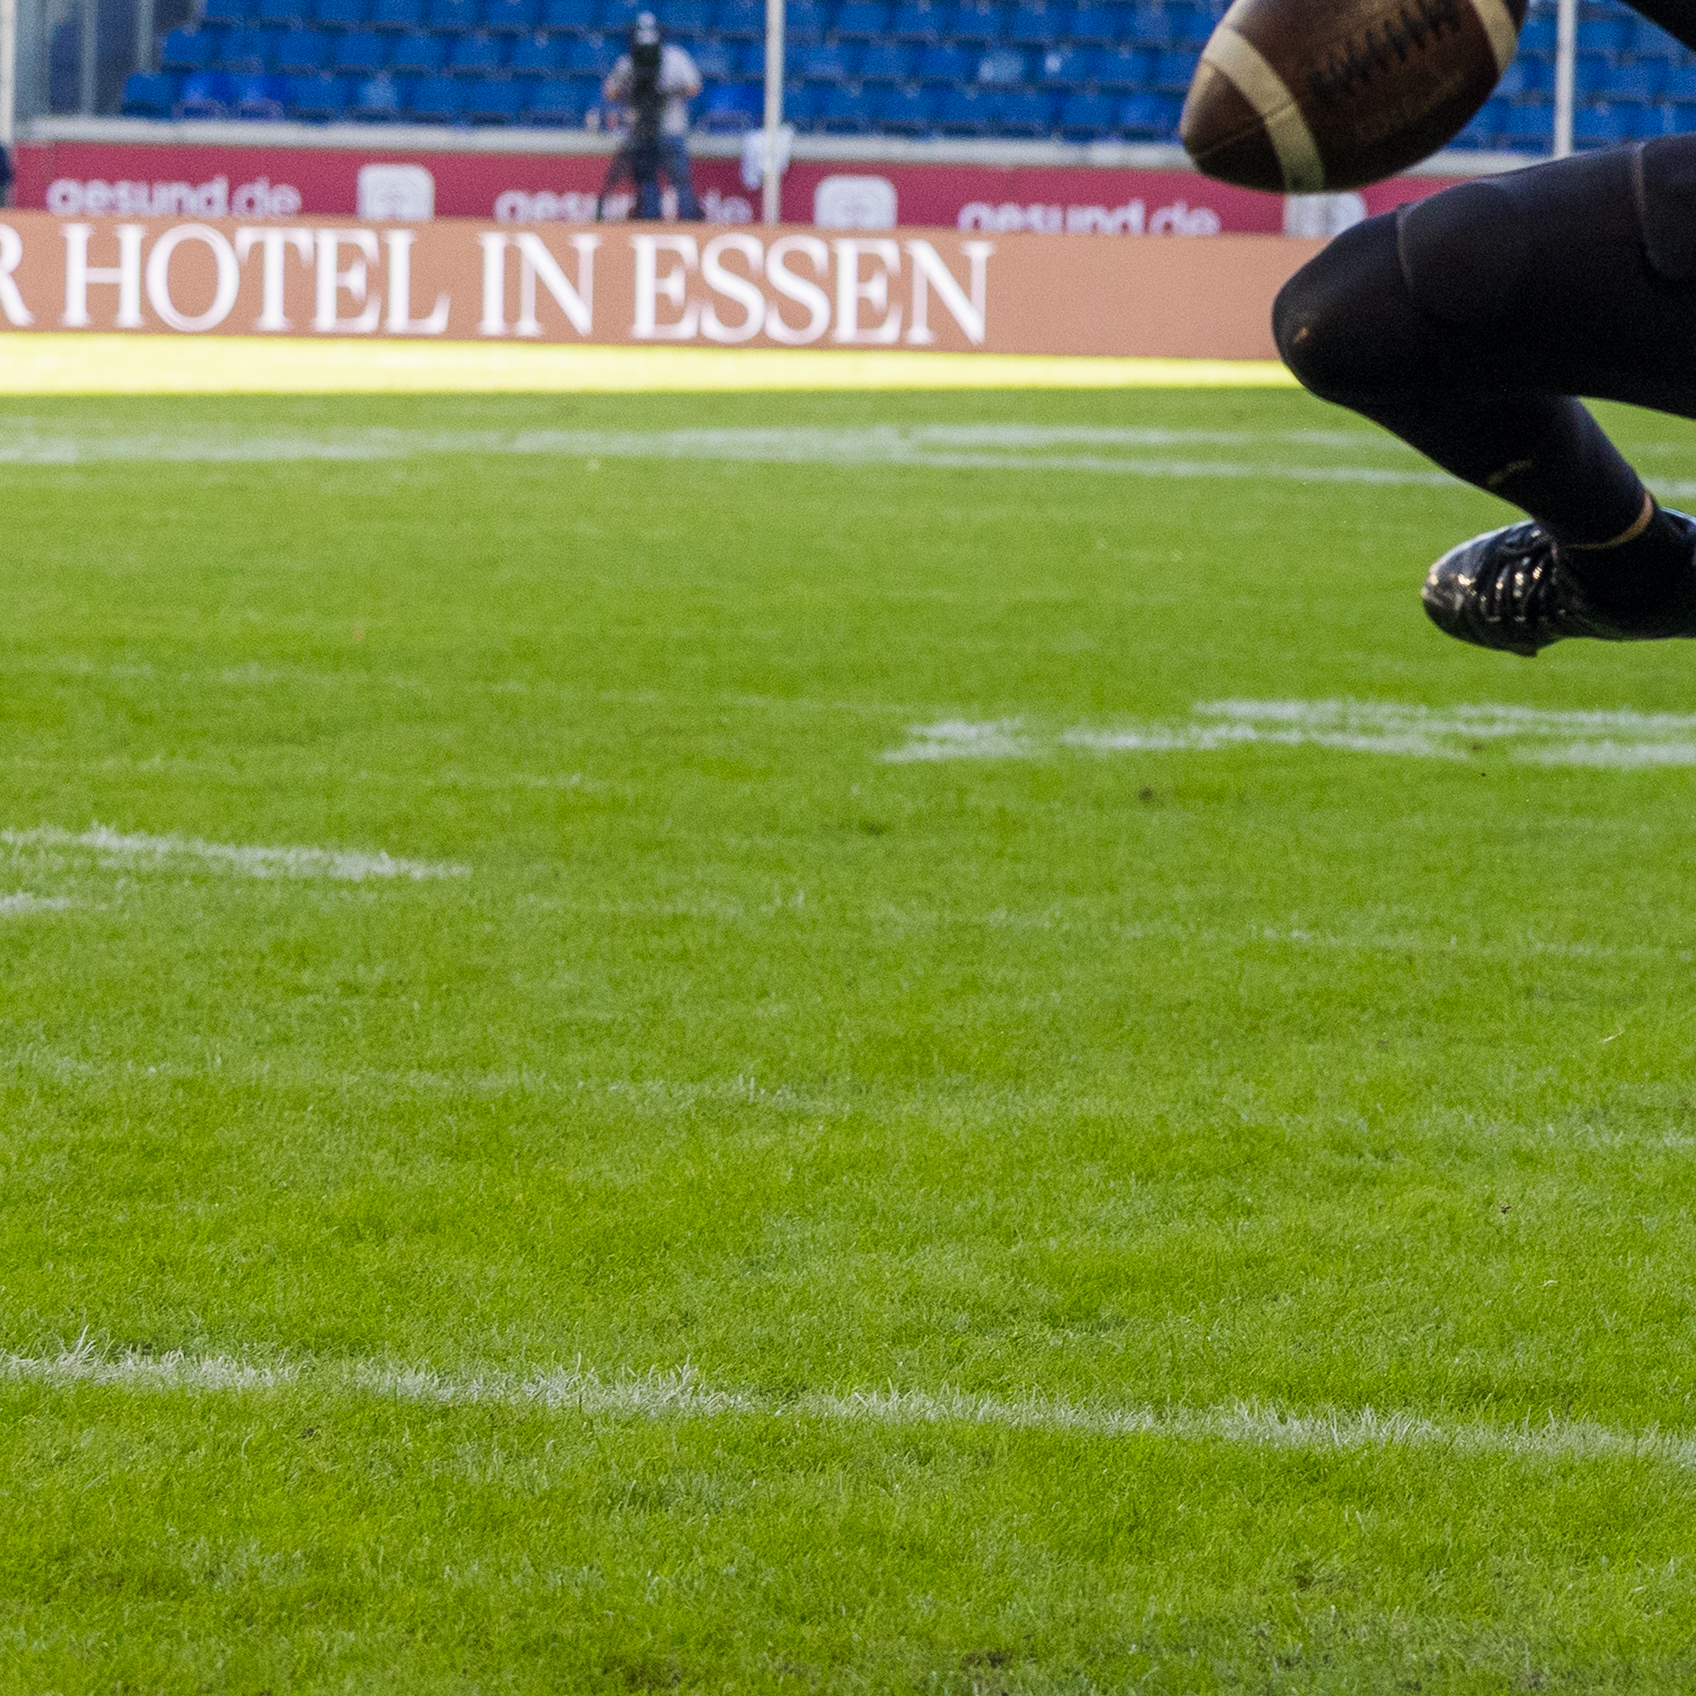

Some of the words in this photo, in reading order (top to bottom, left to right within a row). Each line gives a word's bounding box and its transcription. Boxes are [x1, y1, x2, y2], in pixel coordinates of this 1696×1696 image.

[61, 222, 452, 334] HOTEL
[478, 230, 600, 337] IN
[630, 232, 998, 346] ESSEN
